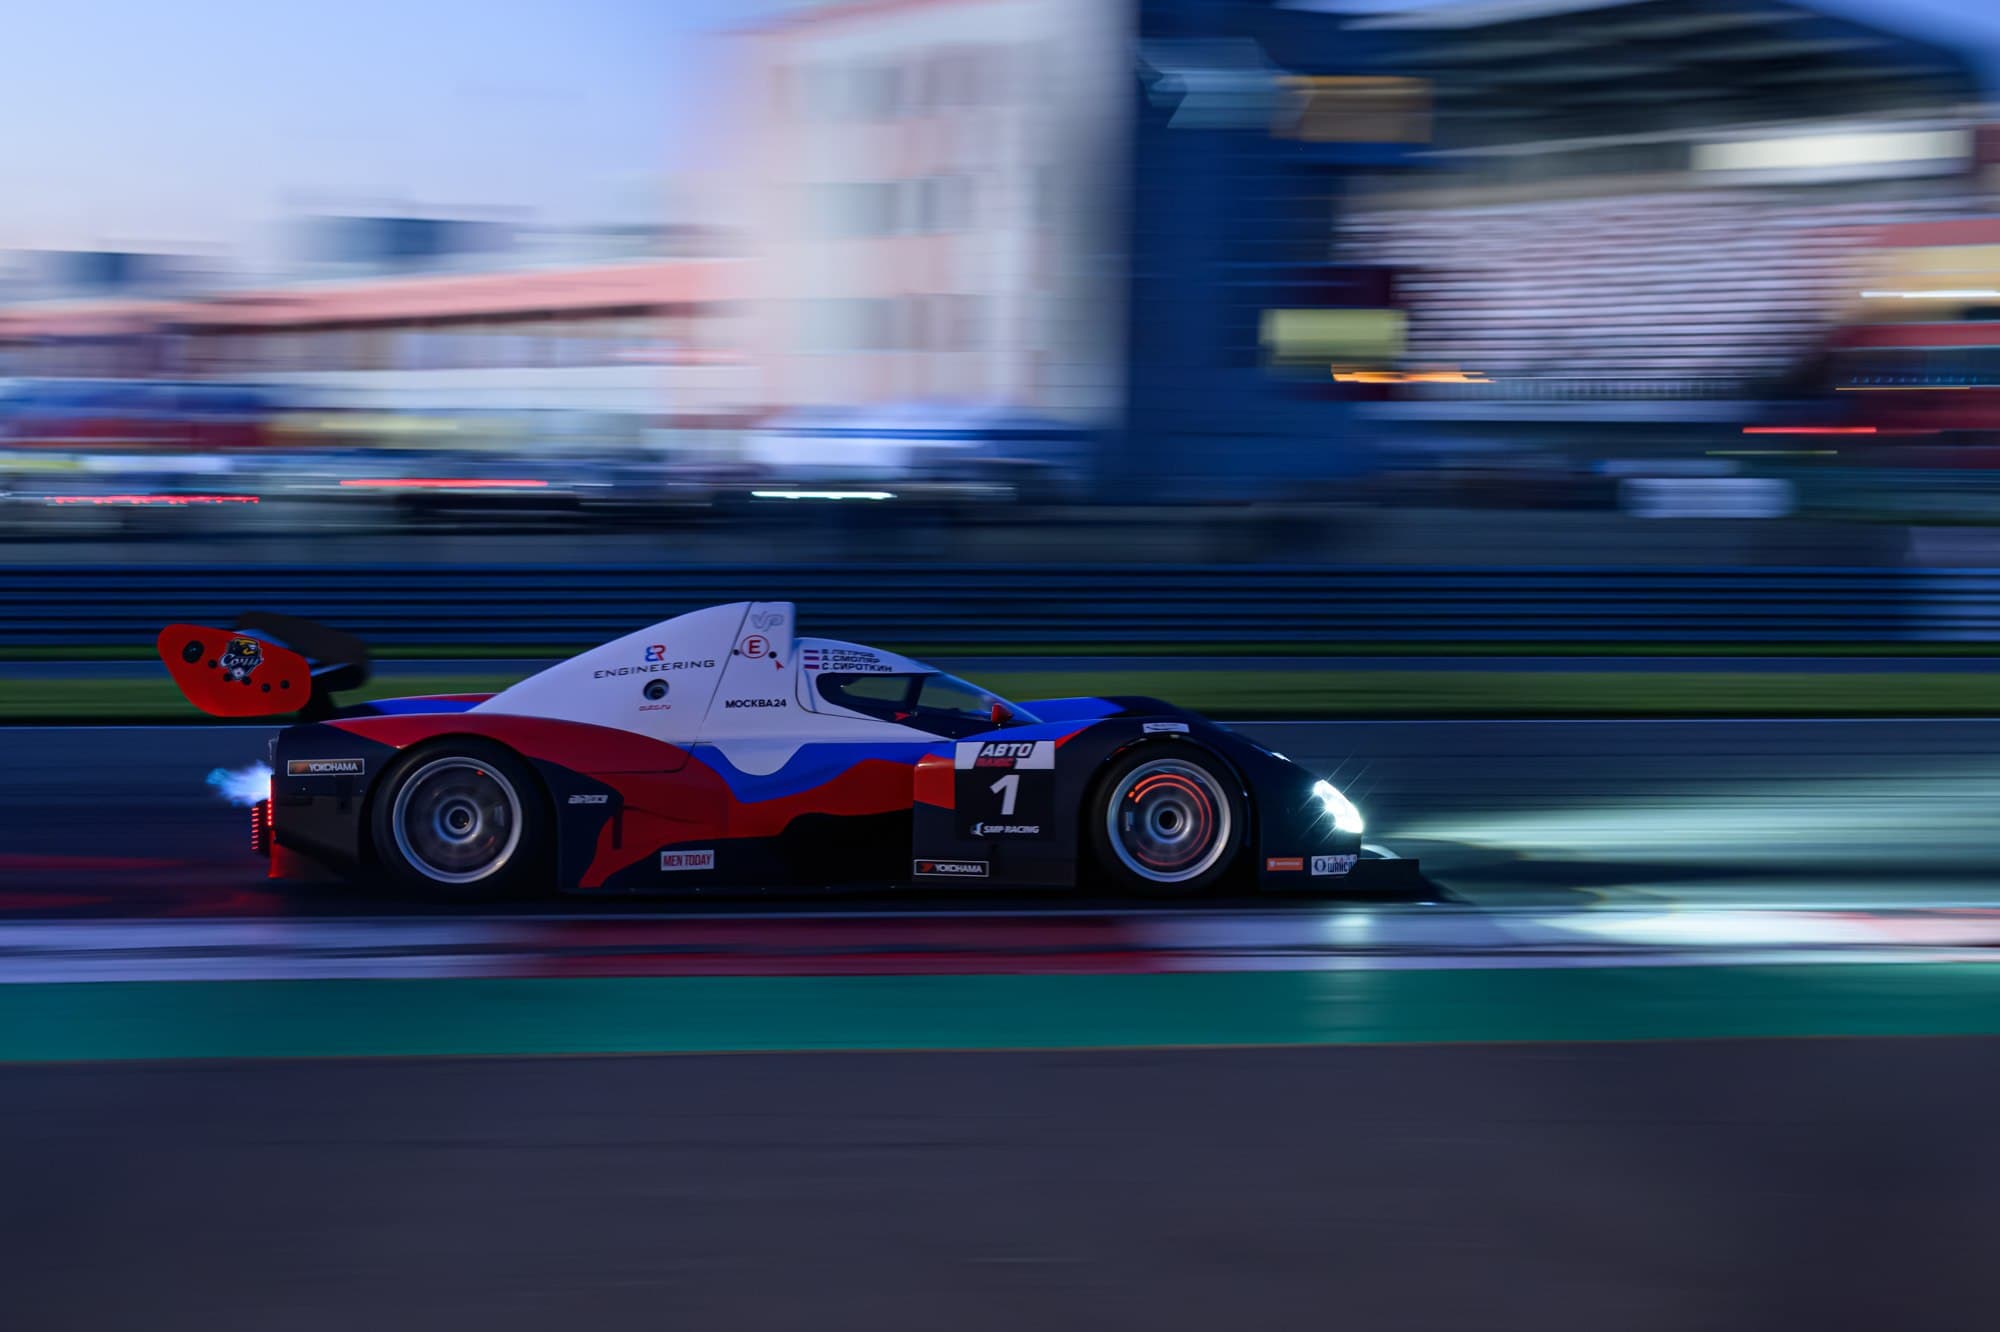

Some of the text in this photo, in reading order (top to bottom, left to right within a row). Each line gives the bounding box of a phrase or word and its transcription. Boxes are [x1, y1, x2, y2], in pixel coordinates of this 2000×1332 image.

[748, 639, 761, 654] E
[593, 660, 716, 679] ENGINEERING
[980, 743, 1033, 757] АВТО
[309, 762, 359, 772] YOKOHAMA
[989, 774, 1020, 815] 1
[1005, 825, 1040, 834] RACING
[663, 854, 712, 867] MEN TODAY
[934, 863, 983, 873] YOKOHAMA
